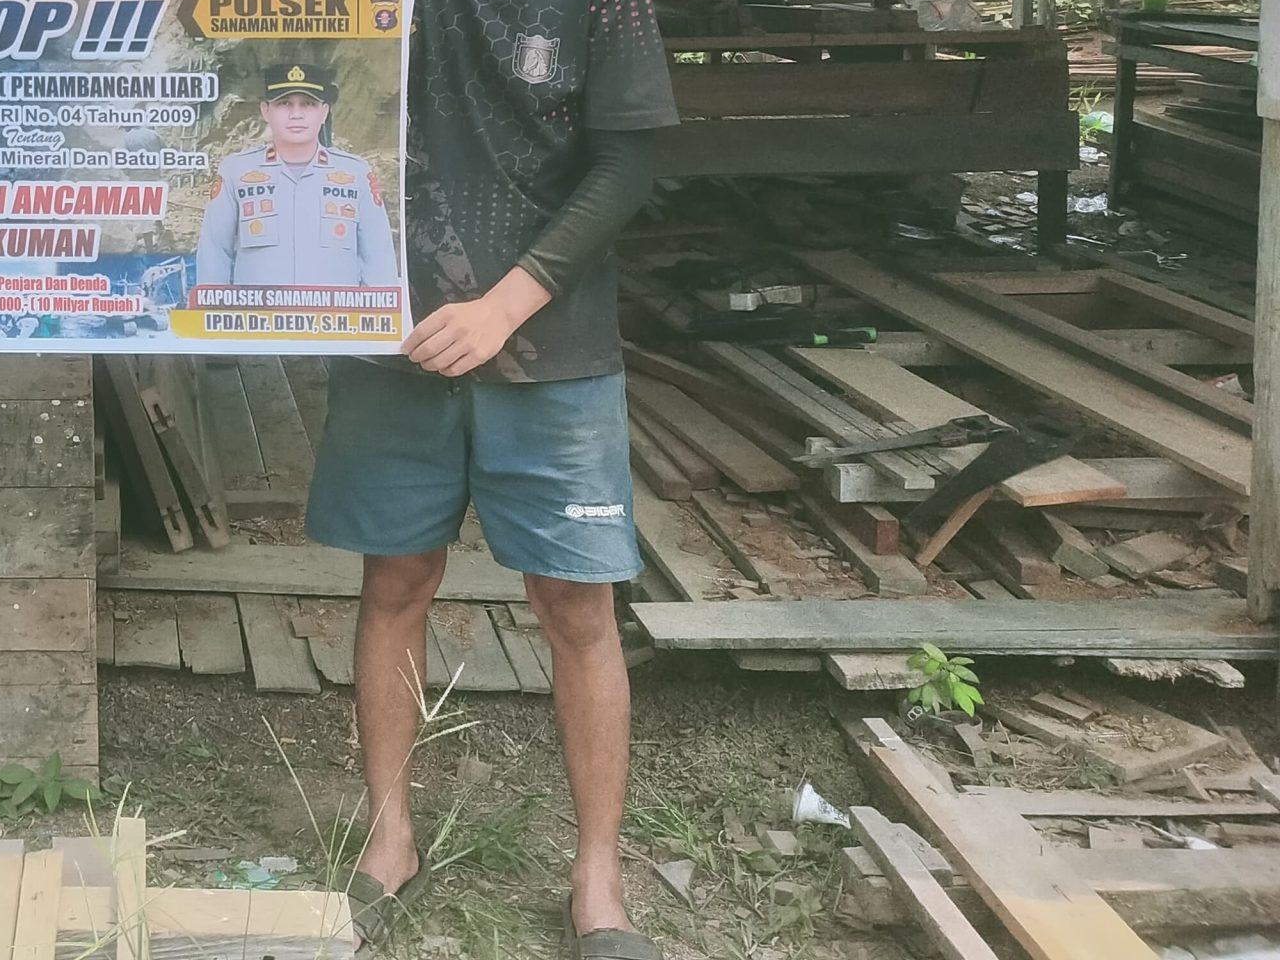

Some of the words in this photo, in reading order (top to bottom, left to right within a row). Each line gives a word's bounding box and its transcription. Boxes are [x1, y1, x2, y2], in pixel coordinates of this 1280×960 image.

[210, 16, 279, 33] SANAMAN
[281, 16, 350, 33] MANTIKEI
[10, 75, 156, 99] PENAMBANGAN
[160, 76, 204, 99] LIAR
[0, 107, 19, 123] RI
[25, 108, 56, 123] No.
[60, 108, 82, 123] 04
[87, 108, 143, 123] Tahun
[149, 108, 192, 124] 2009
[5, 128, 63, 147] Tentang
[1, 150, 67, 166] Mineral
[73, 150, 108, 166] Dan
[115, 151, 157, 166] Batu
[163, 151, 206, 167] Bara
[237, 184, 276, 199] DEDY
[322, 186, 358, 199] POLRI
[11, 185, 164, 216] ANCAMAN
[45, 276, 68, 291] Dan
[70, 276, 108, 292] Denda
[37, 296, 51, 312] 10
[52, 296, 90, 313] Milyar
[92, 297, 133, 313] Rupiah
[197, 288, 265, 306] KAPOLSEK
[265, 289, 331, 308] SANAMAN
[333, 290, 398, 309] MANTIKEI
[205, 313, 245, 331] IPDA
[248, 314, 271, 331] Dr.
[273, 314, 319, 334] DEDY,
[321, 315, 358, 334] S.H.,
[361, 316, 397, 334] M.H.
